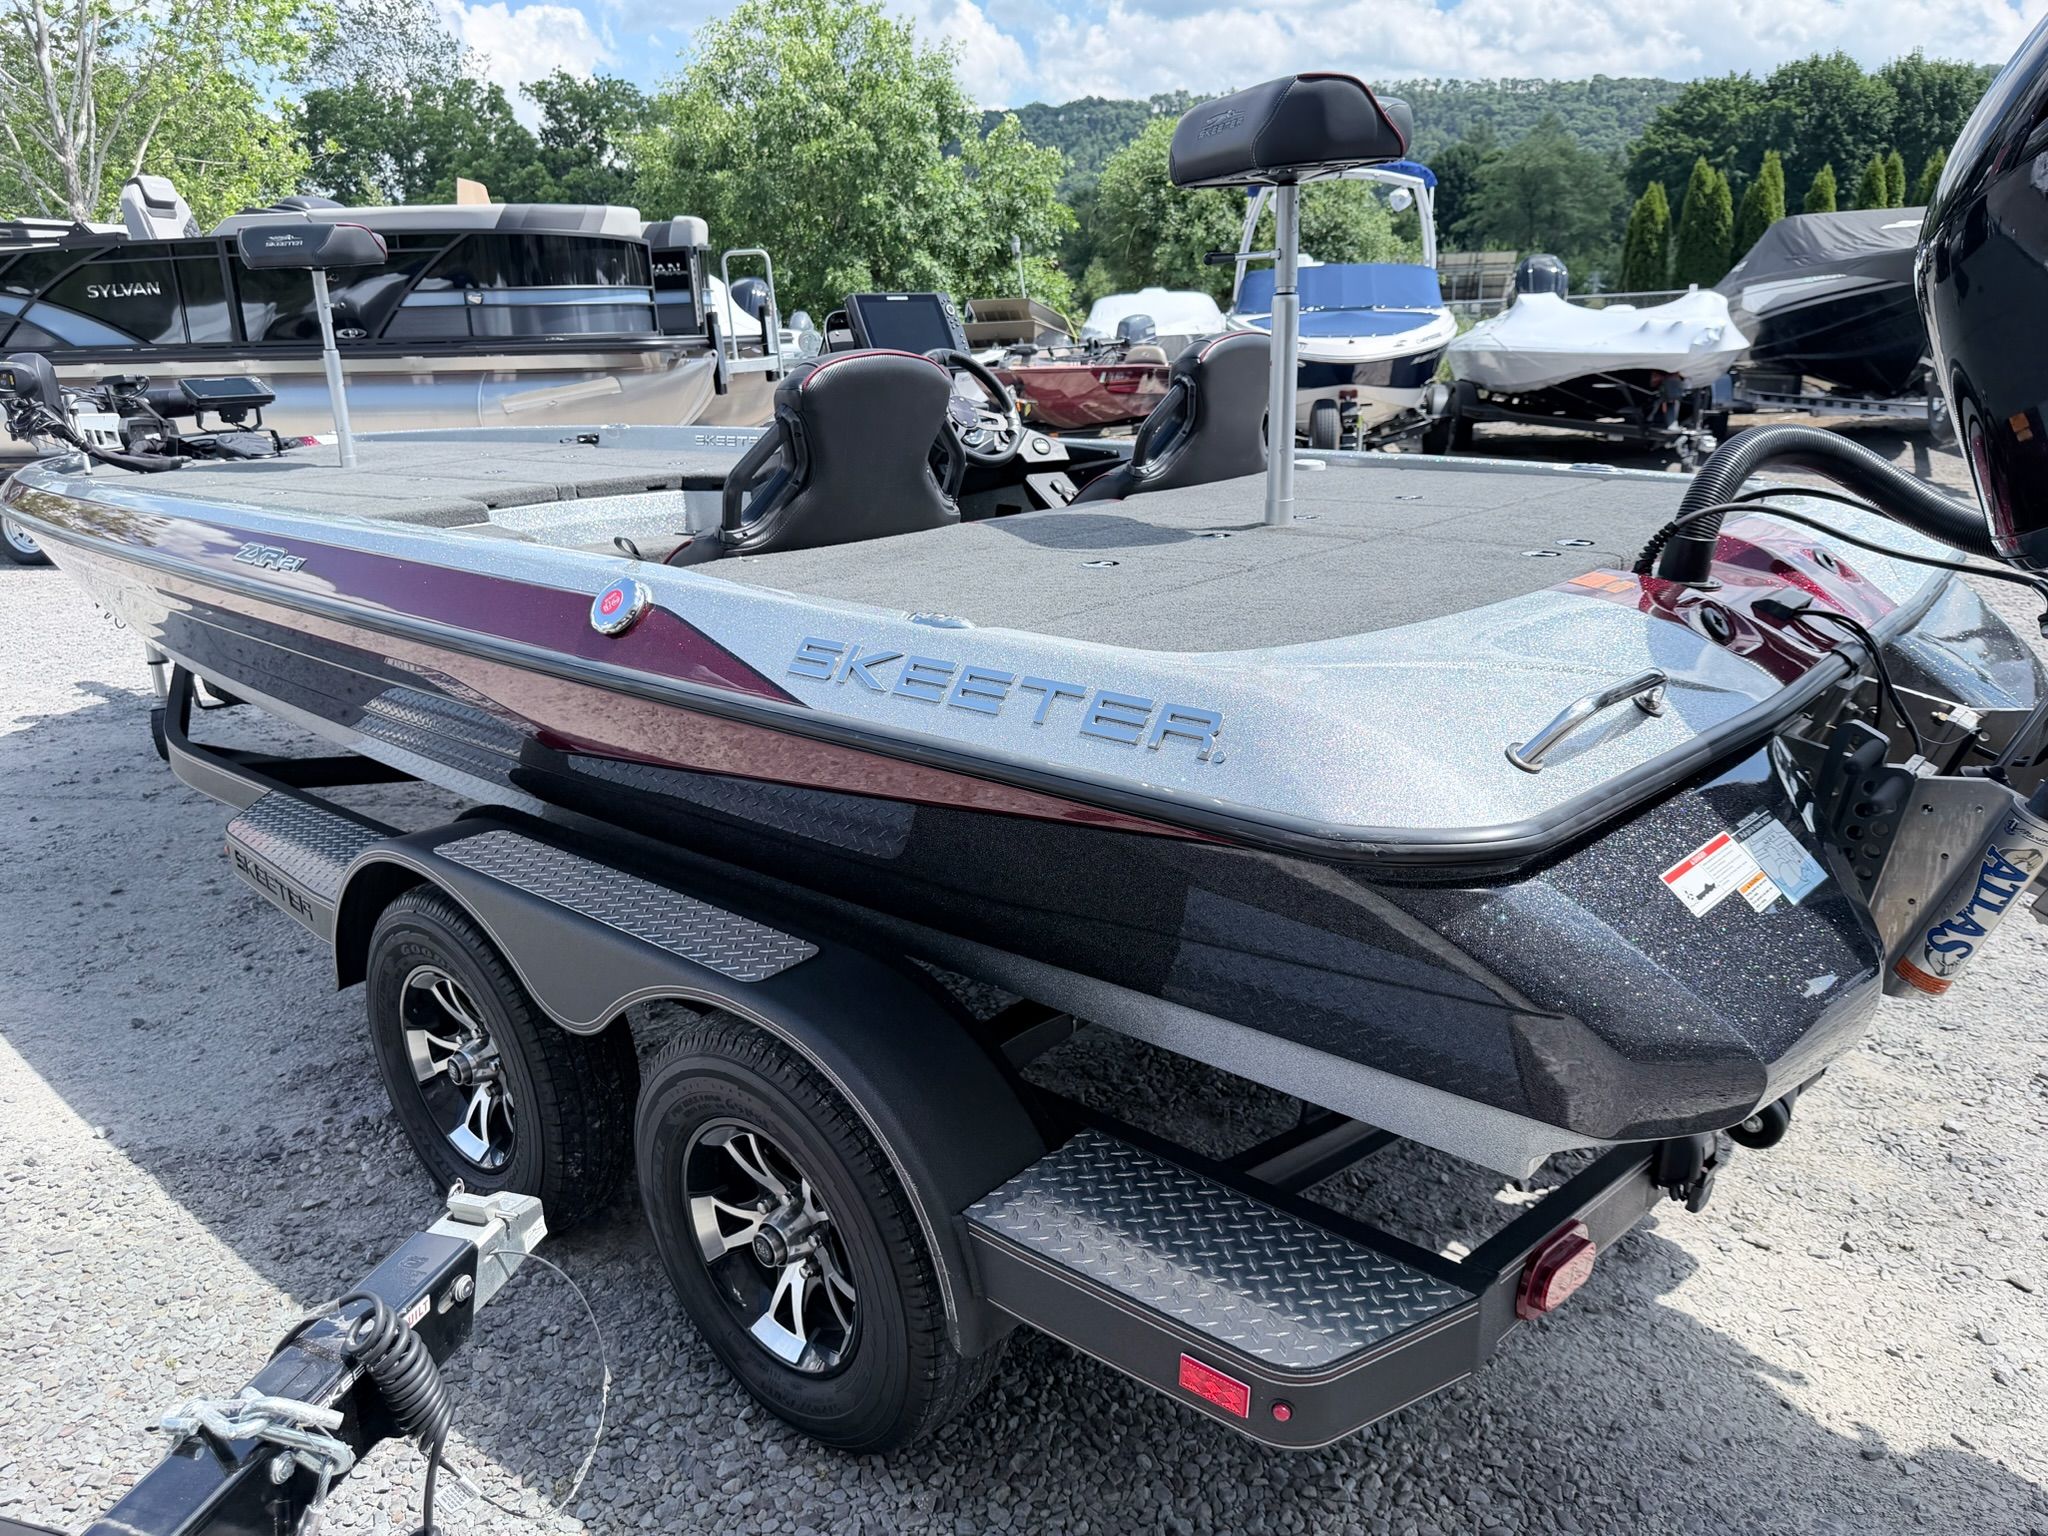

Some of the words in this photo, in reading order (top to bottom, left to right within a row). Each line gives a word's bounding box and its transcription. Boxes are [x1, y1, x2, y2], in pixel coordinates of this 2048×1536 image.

[86, 281, 162, 299] SYLVAN
[694, 434, 763, 448] SKEETE
[787, 636, 1225, 761] SKEETER
[234, 849, 314, 922] SKEETER
[1925, 843, 2030, 960] ATLAS
[408, 1300, 429, 1327] UILT
